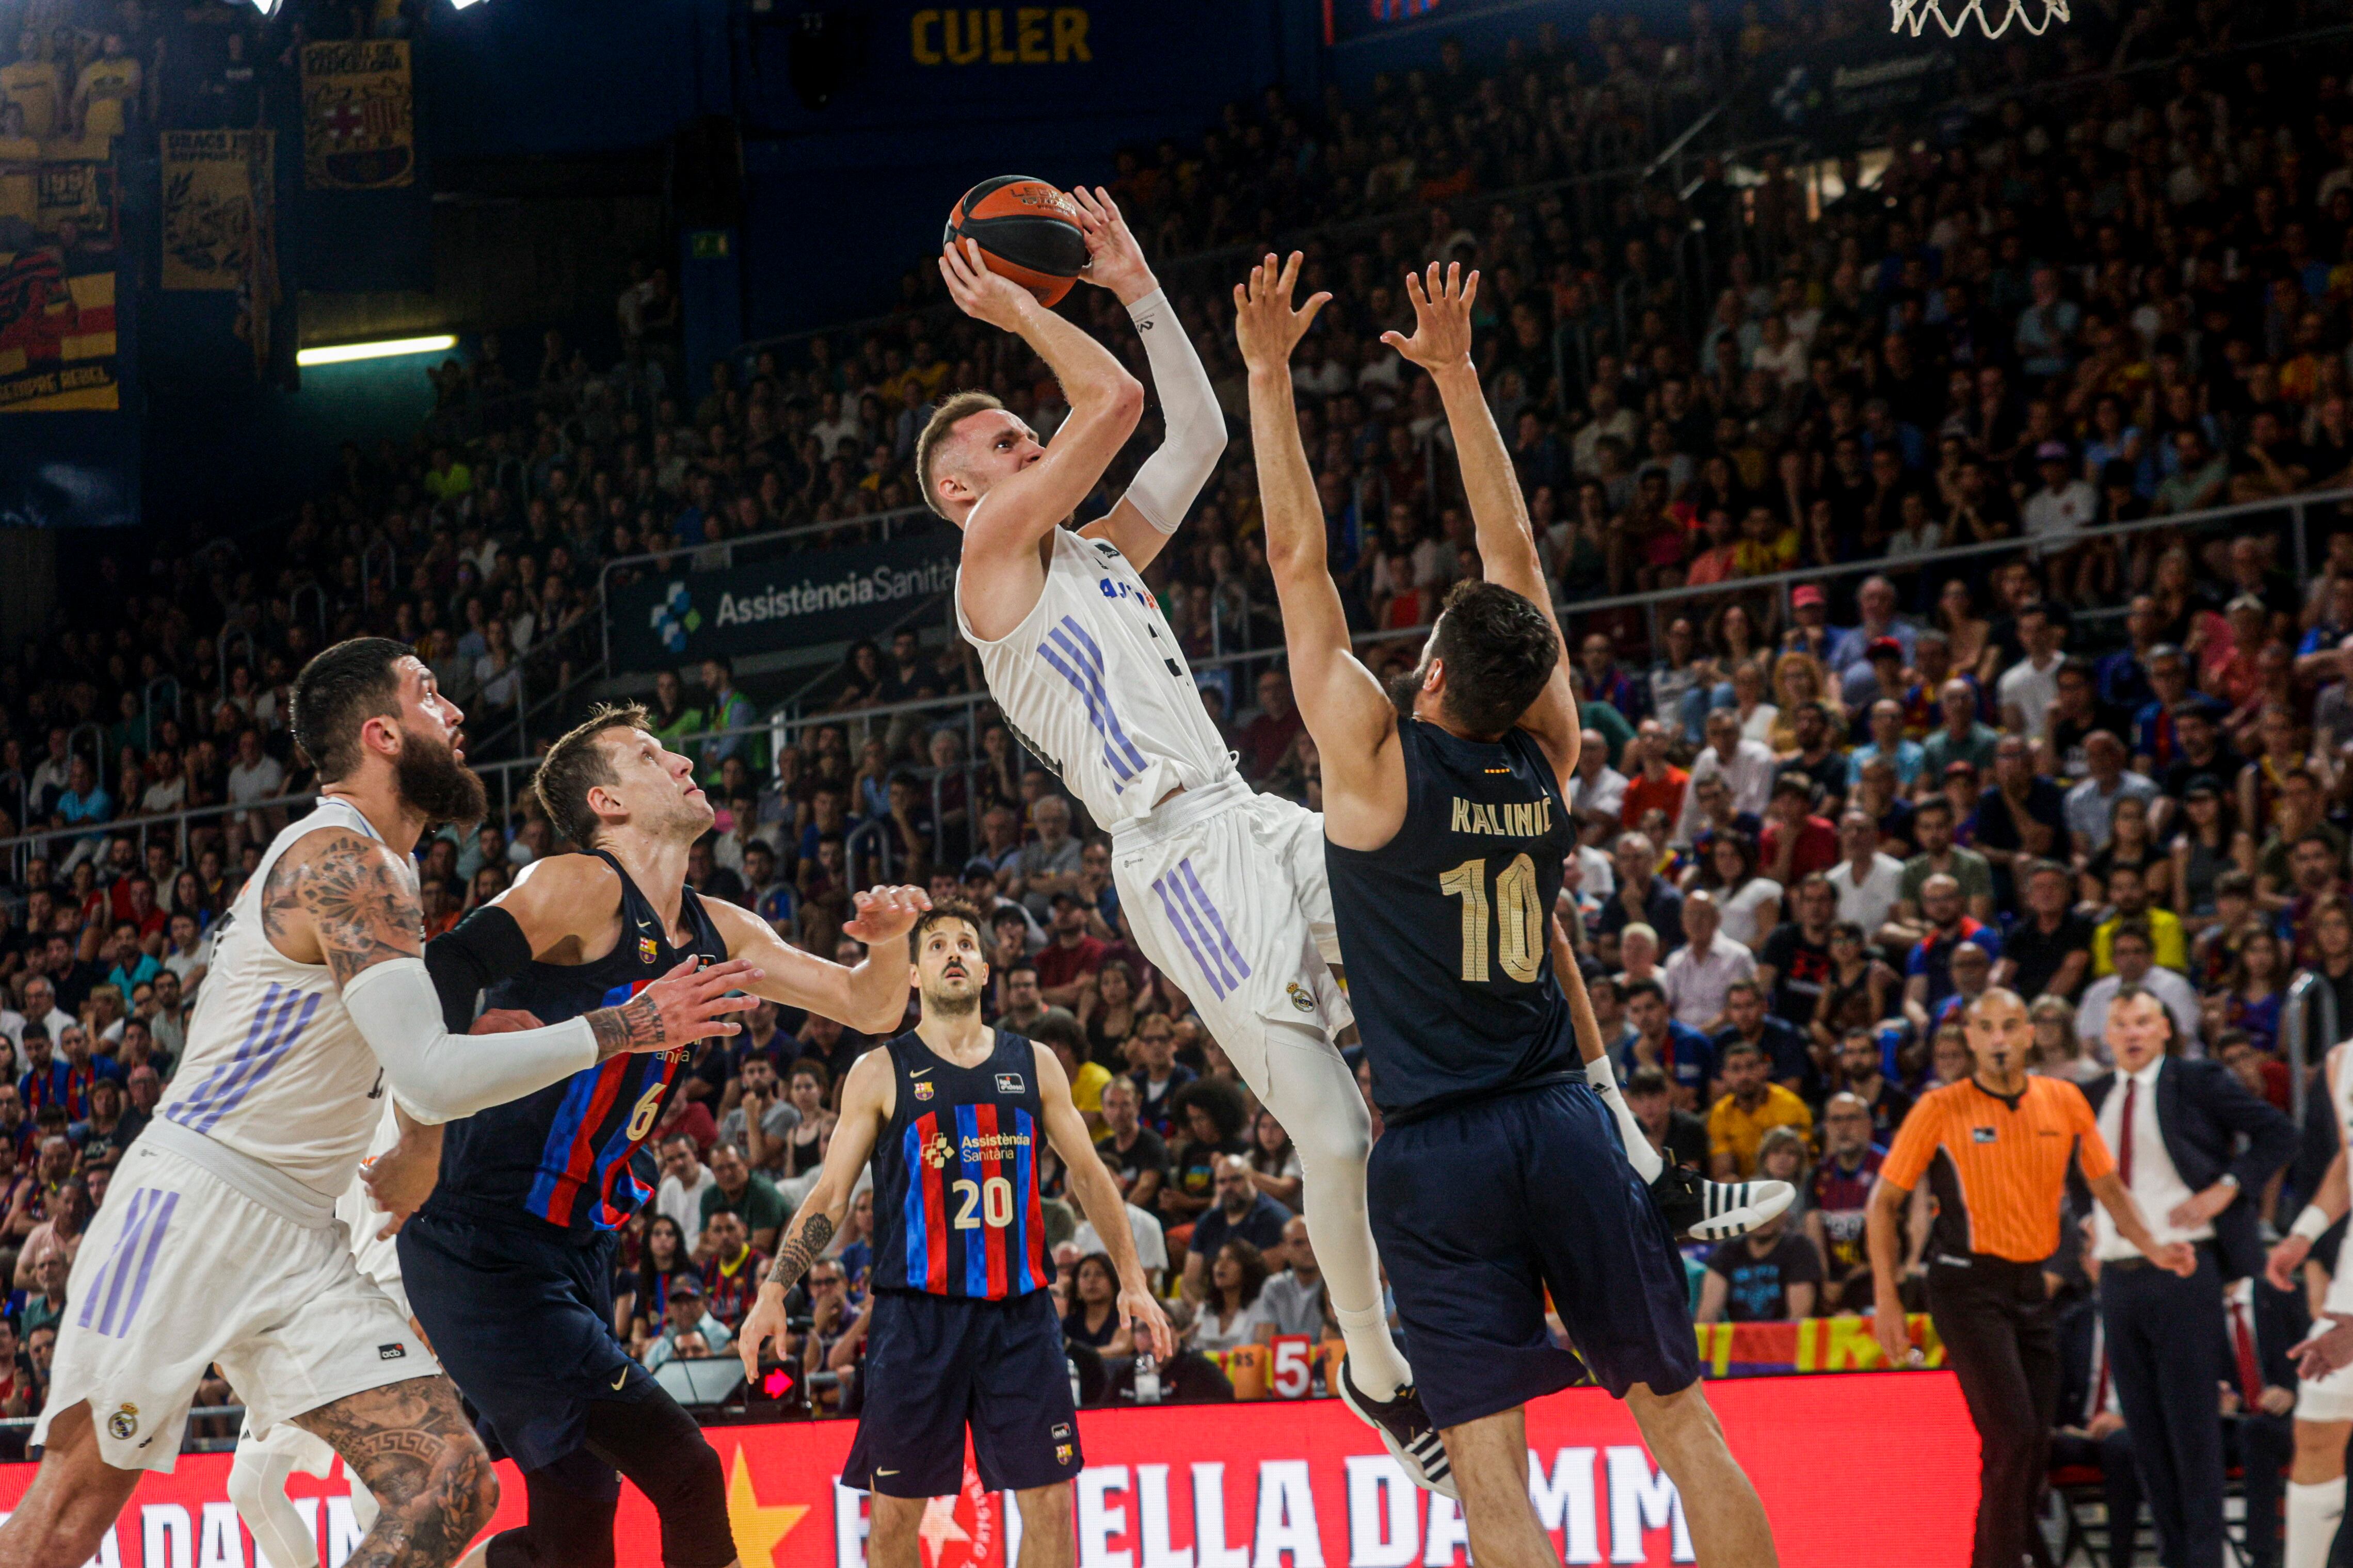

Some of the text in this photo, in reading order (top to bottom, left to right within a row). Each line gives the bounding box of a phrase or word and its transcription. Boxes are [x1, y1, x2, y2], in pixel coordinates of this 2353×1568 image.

[912, 7, 1093, 65] CULER
[1439, 852, 1544, 983] 10
[626, 1082, 667, 1141] 6
[961, 1132, 1030, 1149] Assistència
[962, 1146, 1015, 1163] Sanitària
[952, 1176, 1013, 1230] 20
[382, 1349, 401, 1359] acb
[1275, 1341, 1310, 1397] 5
